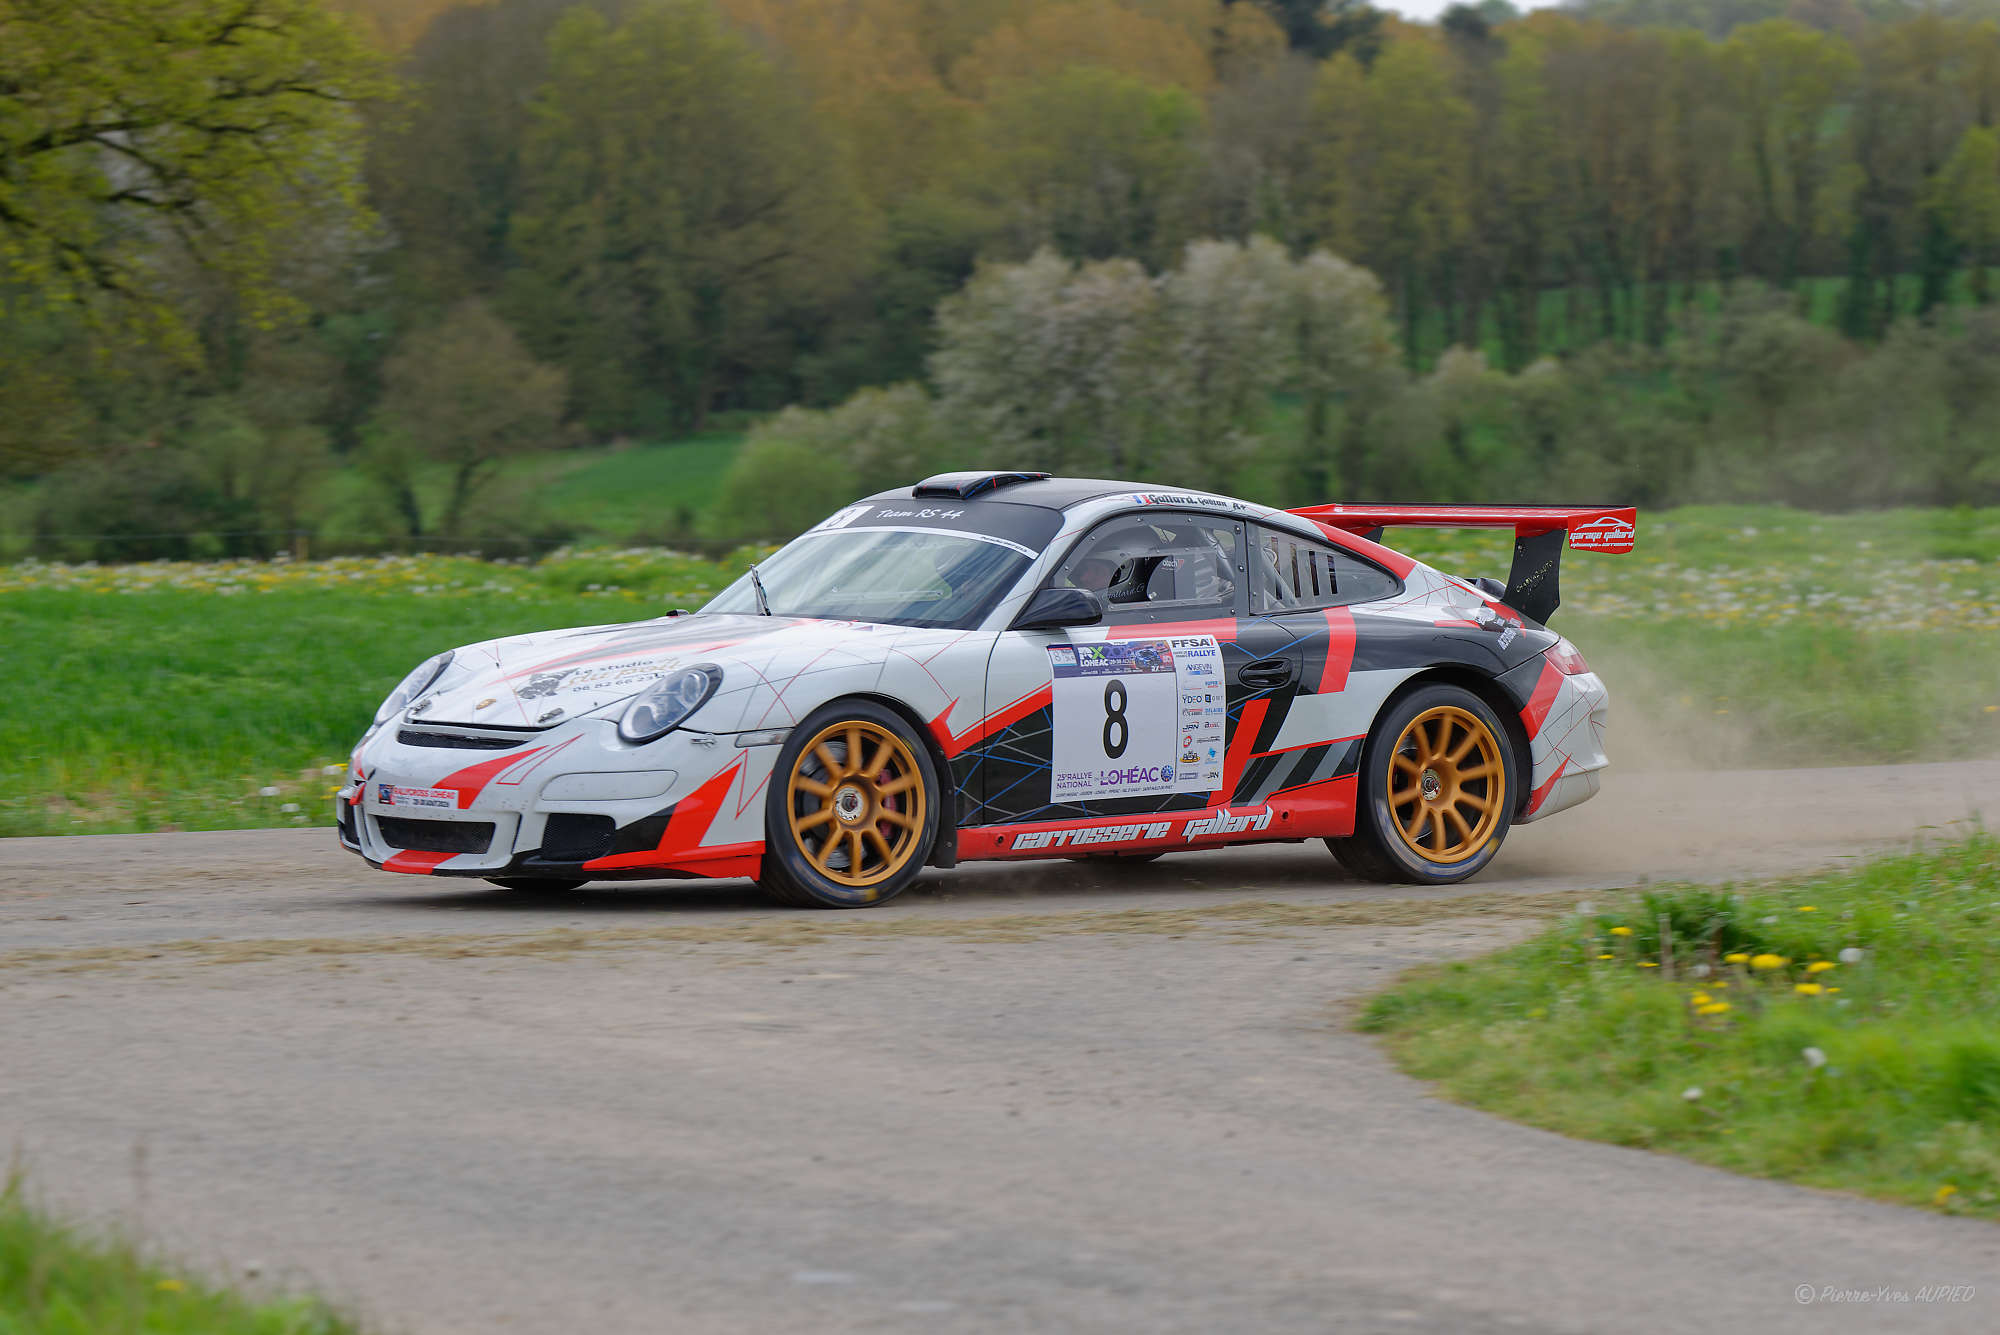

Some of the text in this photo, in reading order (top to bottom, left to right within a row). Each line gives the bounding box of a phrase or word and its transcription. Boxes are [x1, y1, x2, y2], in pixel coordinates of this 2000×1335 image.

[876, 509, 965, 520] Team RS 44
[1570, 528, 1635, 542] garage gallard
[1171, 638, 1211, 648] FFSA
[1188, 649, 1216, 657] RALLYE
[600, 660, 654, 671] studio
[1080, 659, 1109, 667] LOHEAC
[1103, 679, 1129, 759] 8
[1067, 771, 1092, 780] RALLYE
[1100, 766, 1159, 786] LOHÉAC
[1057, 781, 1092, 789] NATIONAL
[1010, 804, 1274, 851] carrosserie gallard
